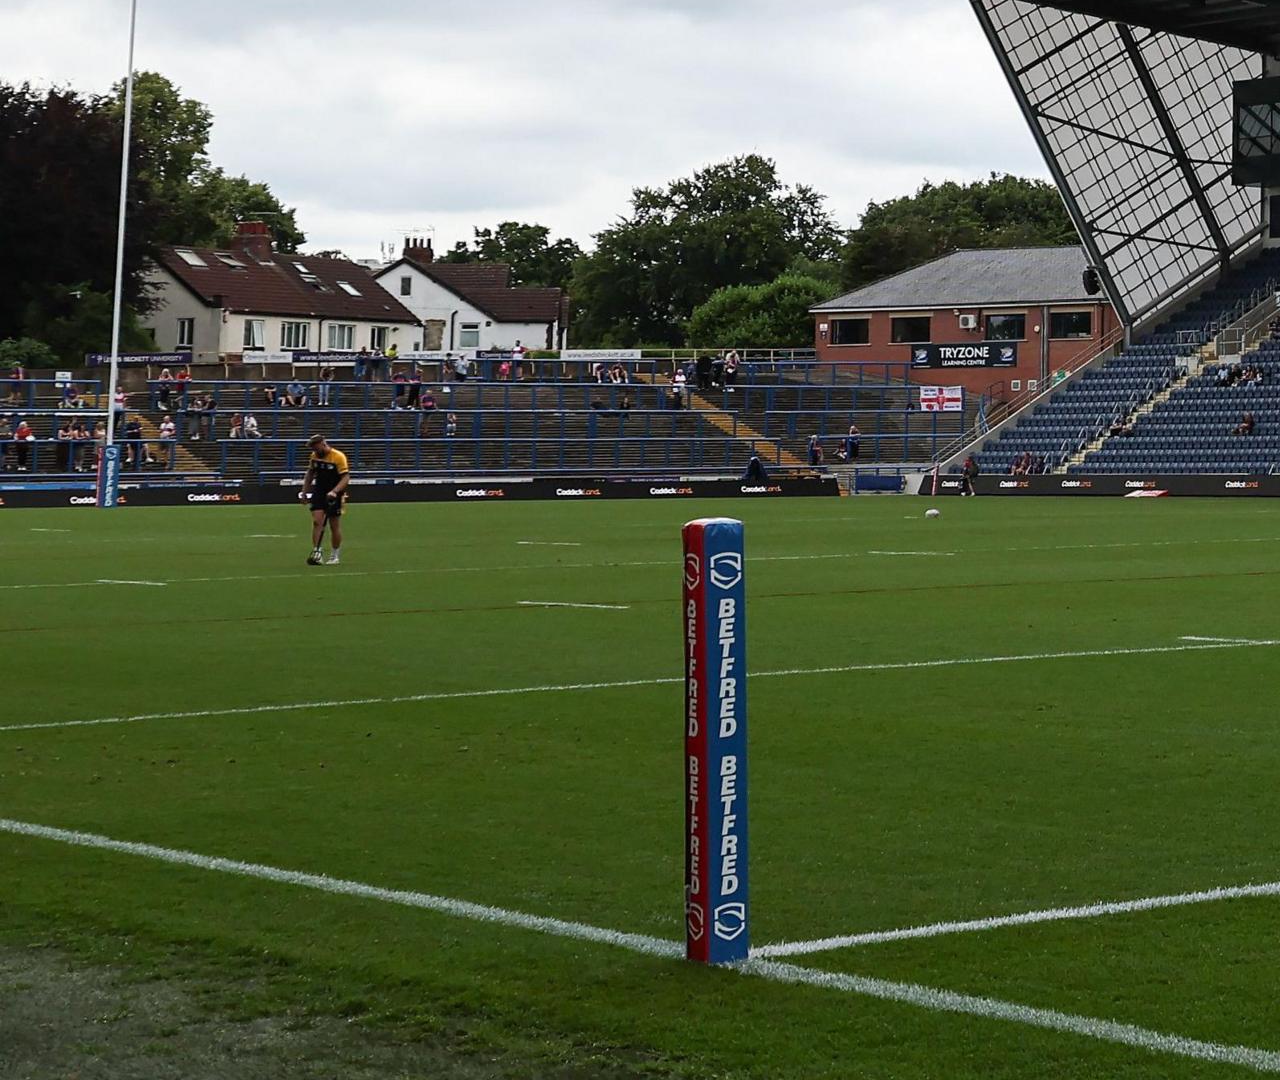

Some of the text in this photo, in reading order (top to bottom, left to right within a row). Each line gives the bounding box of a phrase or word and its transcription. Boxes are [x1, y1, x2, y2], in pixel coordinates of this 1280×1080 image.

[939, 347, 990, 359] TRYZONE
[686, 599, 699, 738] BETFRED
[719, 598, 737, 738] BETFRED
[688, 755, 700, 895] BETFRED
[719, 755, 739, 897] BETFRED
